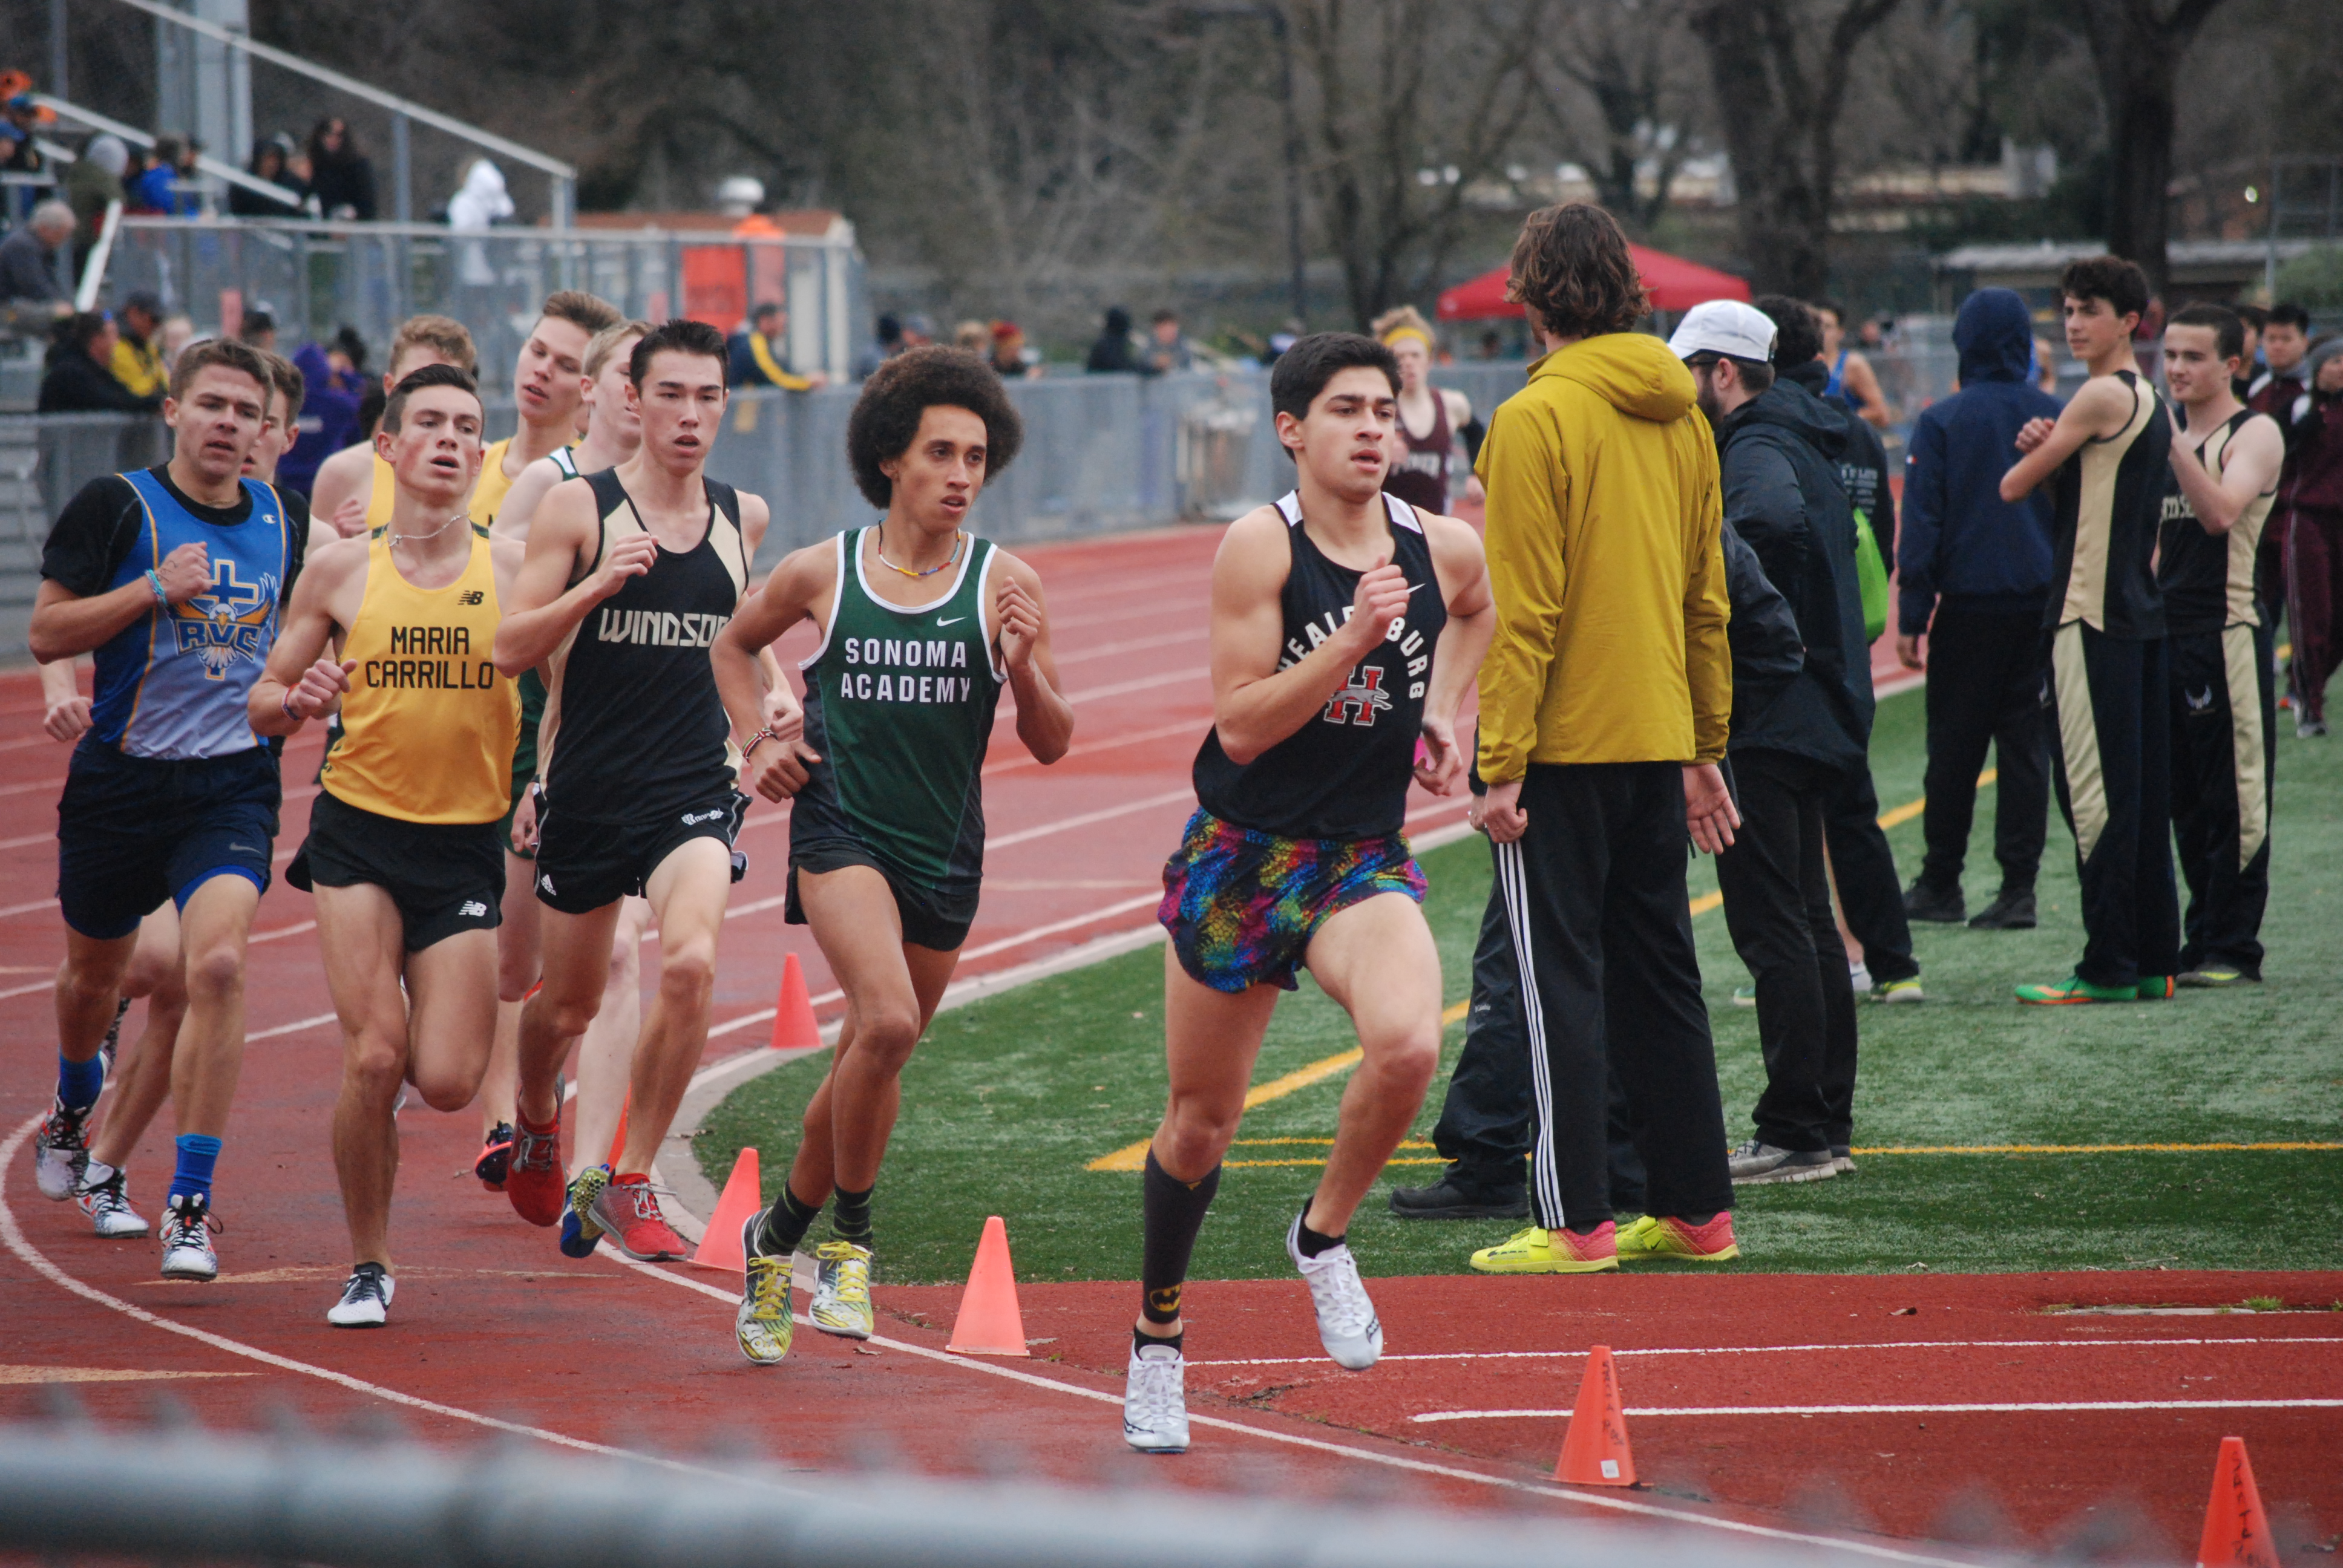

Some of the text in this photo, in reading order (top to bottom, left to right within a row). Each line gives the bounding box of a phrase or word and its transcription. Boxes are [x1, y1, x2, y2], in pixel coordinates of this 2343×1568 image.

[176, 619, 261, 657] RVC
[391, 626, 470, 655] MARIA
[845, 638, 966, 668] SONOMA
[365, 660, 494, 690] CARRILLO
[841, 673, 971, 703] ACADEMY
